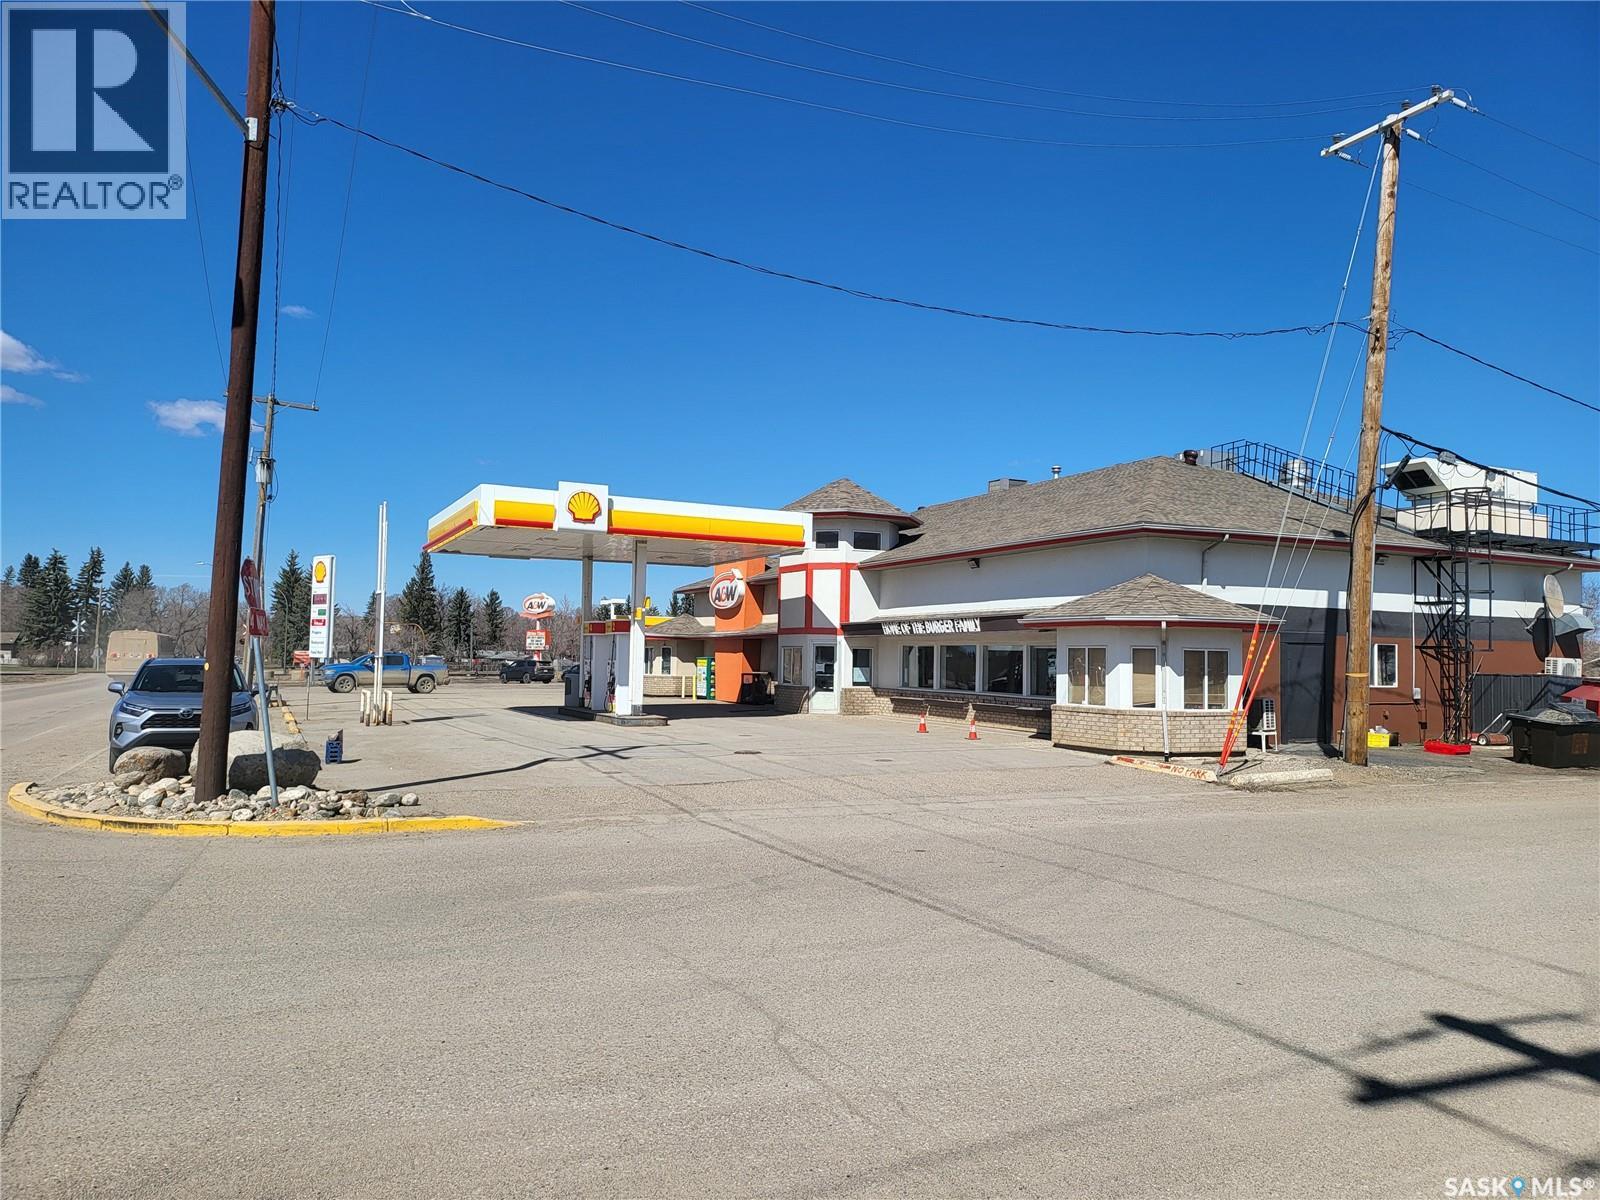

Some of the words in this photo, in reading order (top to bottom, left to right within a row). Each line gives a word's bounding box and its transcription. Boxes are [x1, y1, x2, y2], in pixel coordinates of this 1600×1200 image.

[713, 585, 737, 602] A&W
[527, 601, 546, 610] A&W
[925, 619, 955, 634] BURGER
[954, 617, 981, 633] FAMILY
[1171, 765, 1185, 774] NO
[1185, 767, 1208, 779] PARK
